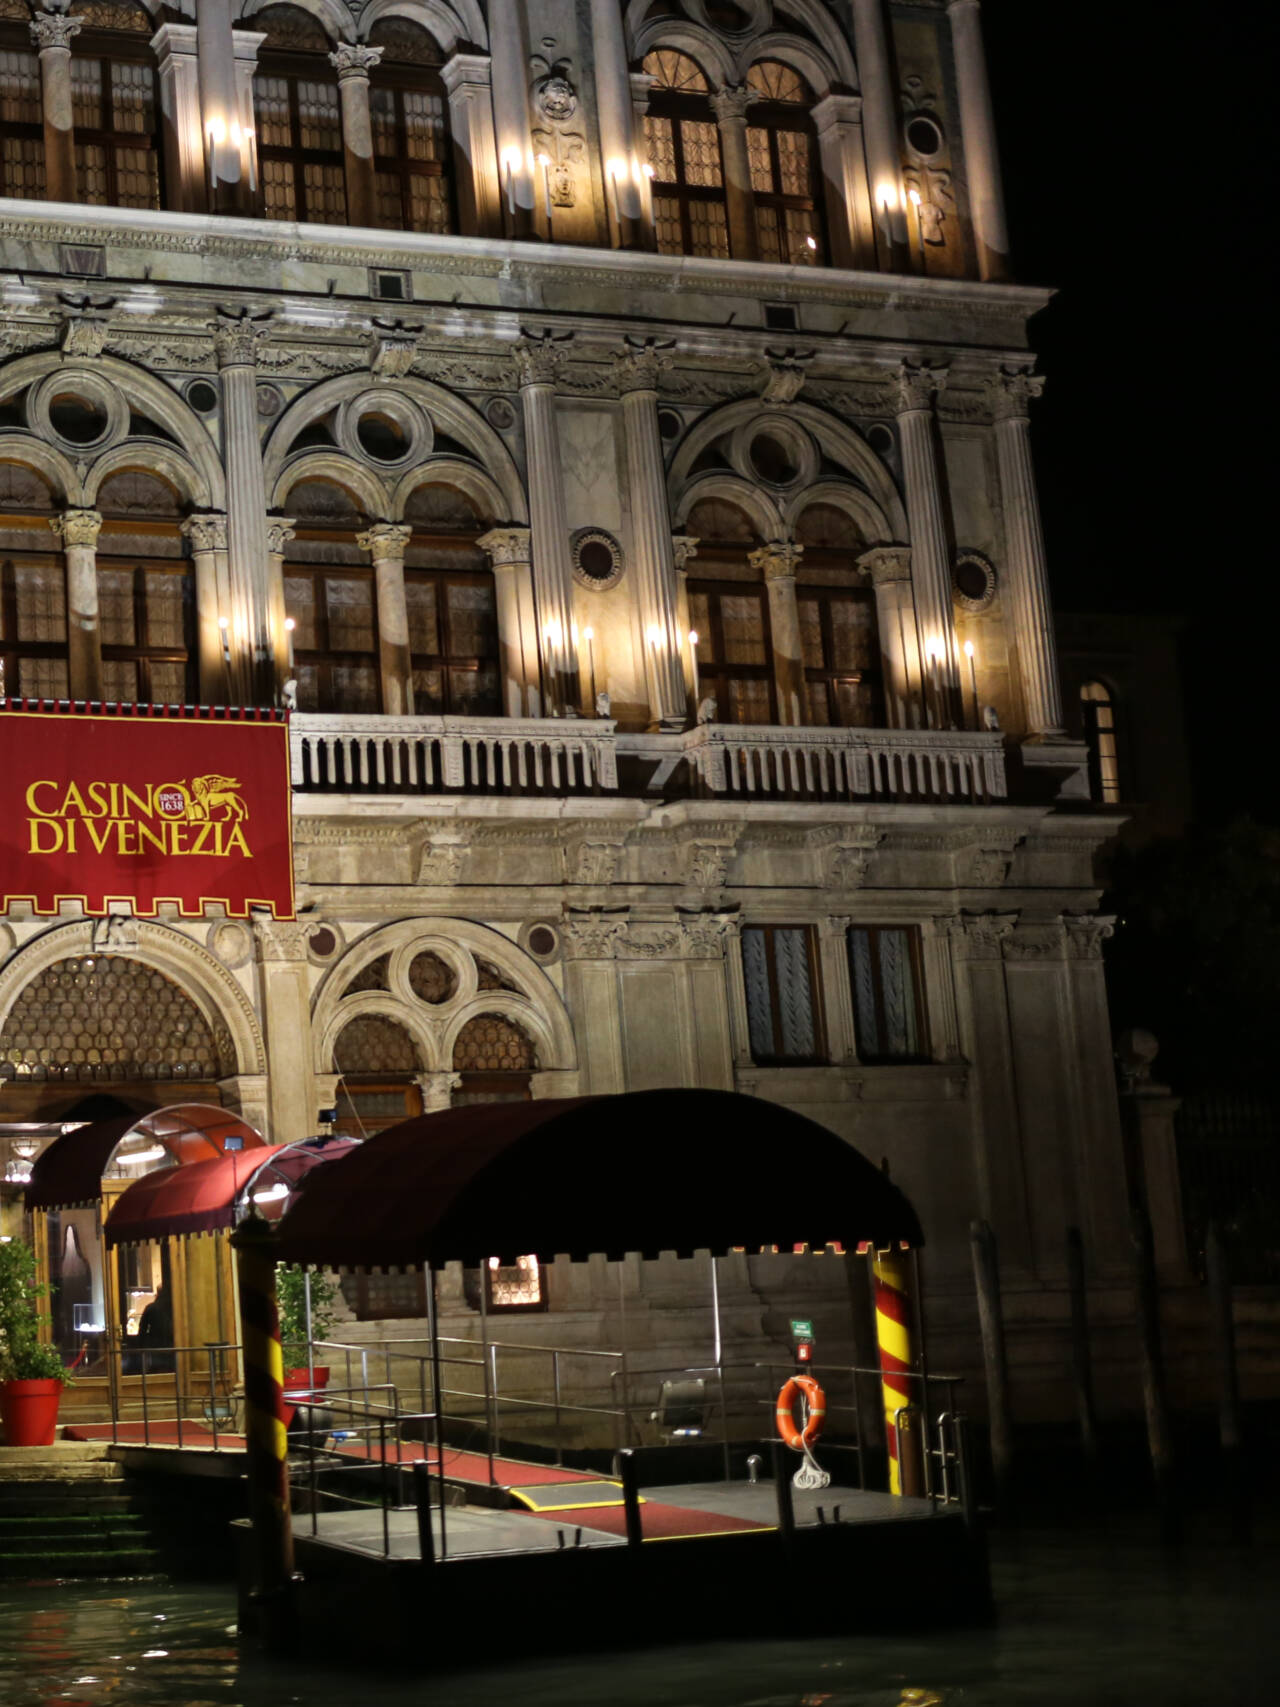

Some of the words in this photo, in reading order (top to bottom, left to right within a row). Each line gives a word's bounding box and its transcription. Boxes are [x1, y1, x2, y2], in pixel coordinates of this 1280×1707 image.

[159, 792, 183, 801] SINCE
[160, 801, 184, 811] 1638
[26, 818, 77, 854] DI
[82, 818, 253, 857] VENEZIA
